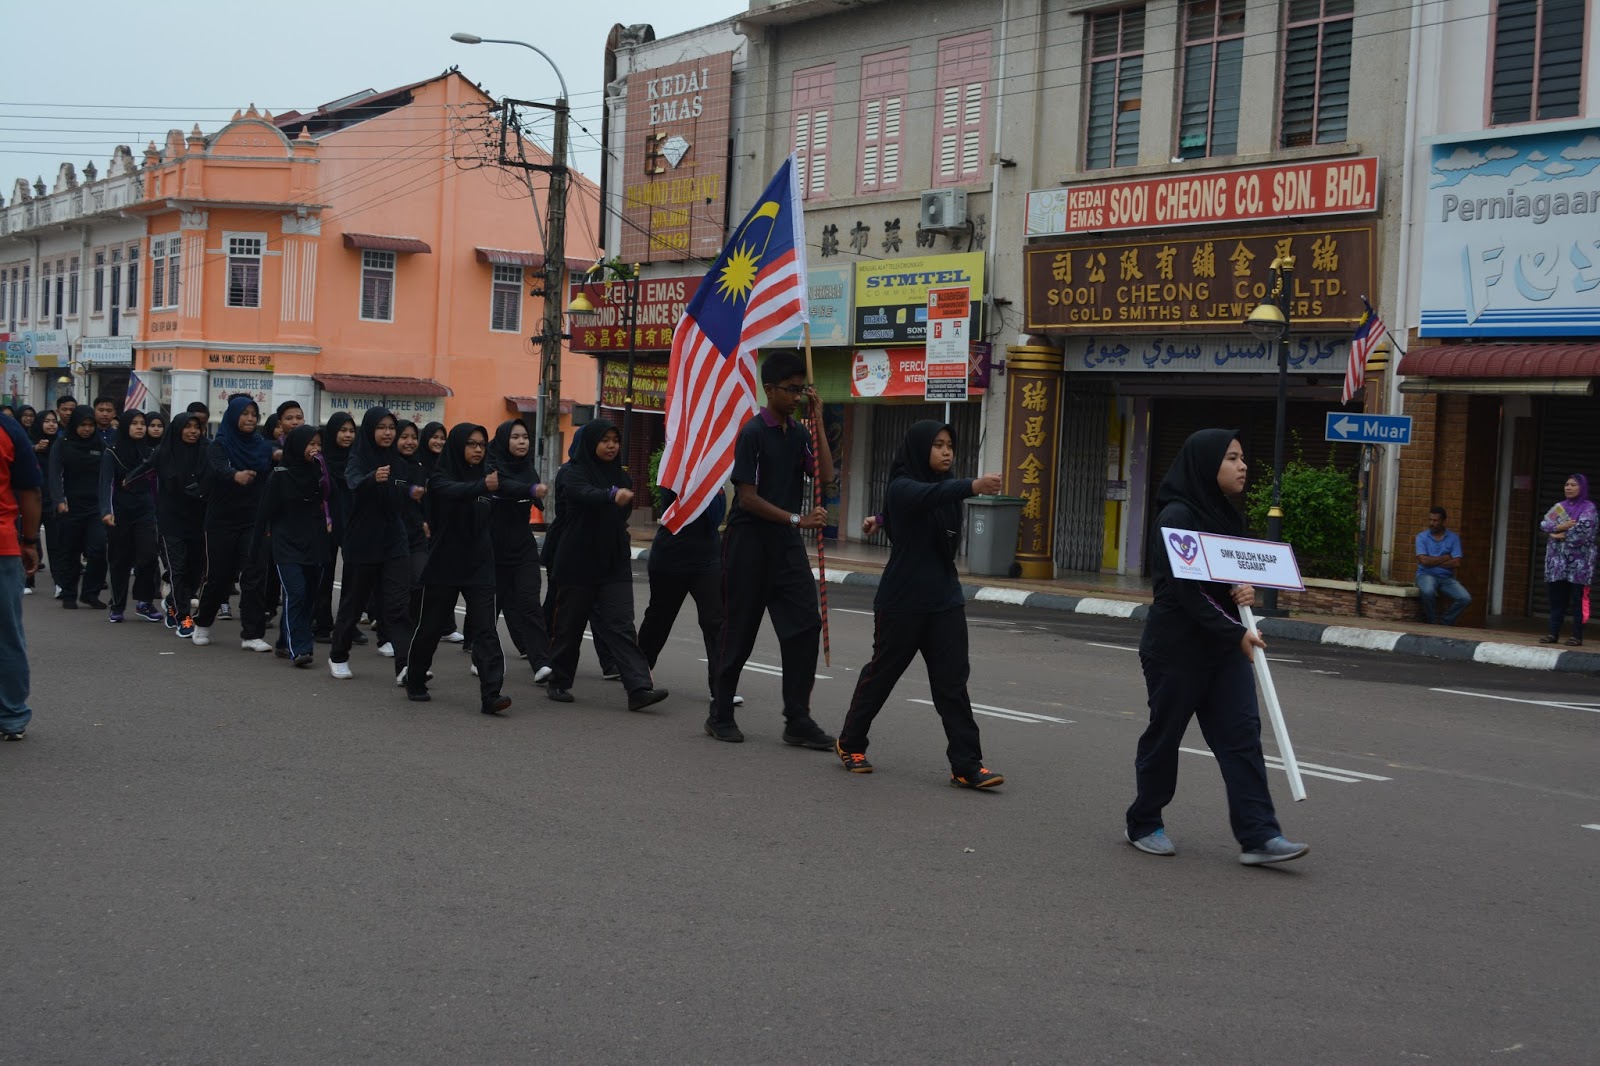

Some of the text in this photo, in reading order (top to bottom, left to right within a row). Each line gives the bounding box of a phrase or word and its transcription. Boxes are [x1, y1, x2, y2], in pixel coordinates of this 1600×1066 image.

[646, 68, 709, 101] KEDAI
[649, 96, 703, 126] EMAS
[1069, 189, 1106, 210] KEDAI
[1109, 164, 1370, 225] SOOI CHEONG CO. SDN. BHD.
[1070, 209, 1103, 228] EMAS
[866, 270, 971, 289] STMTEL
[647, 281, 685, 302] EMAS
[1047, 287, 1095, 306] SOOI
[1116, 282, 1210, 303] CHEONG
[1294, 278, 1347, 297] LTD.
[671, 302, 689, 325] SD
[1070, 300, 1323, 321] GOLD SMITHS & JEWEERS
[863, 328, 894, 339] SAMSUNG
[907, 326, 928, 334] SONY
[209, 354, 271, 365] NAN YANG COFFEE SHOP
[213, 377, 273, 390] NAN YANG COFFEE SHOP
[331, 397, 349, 409] NAN
[353, 398, 375, 409] YANG
[414, 400, 435, 412] SHOP
[1363, 420, 1407, 439] Muar
[1220, 548, 1277, 564] SMK BULOH KASAP
[1237, 560, 1267, 572] SEGAMAT
